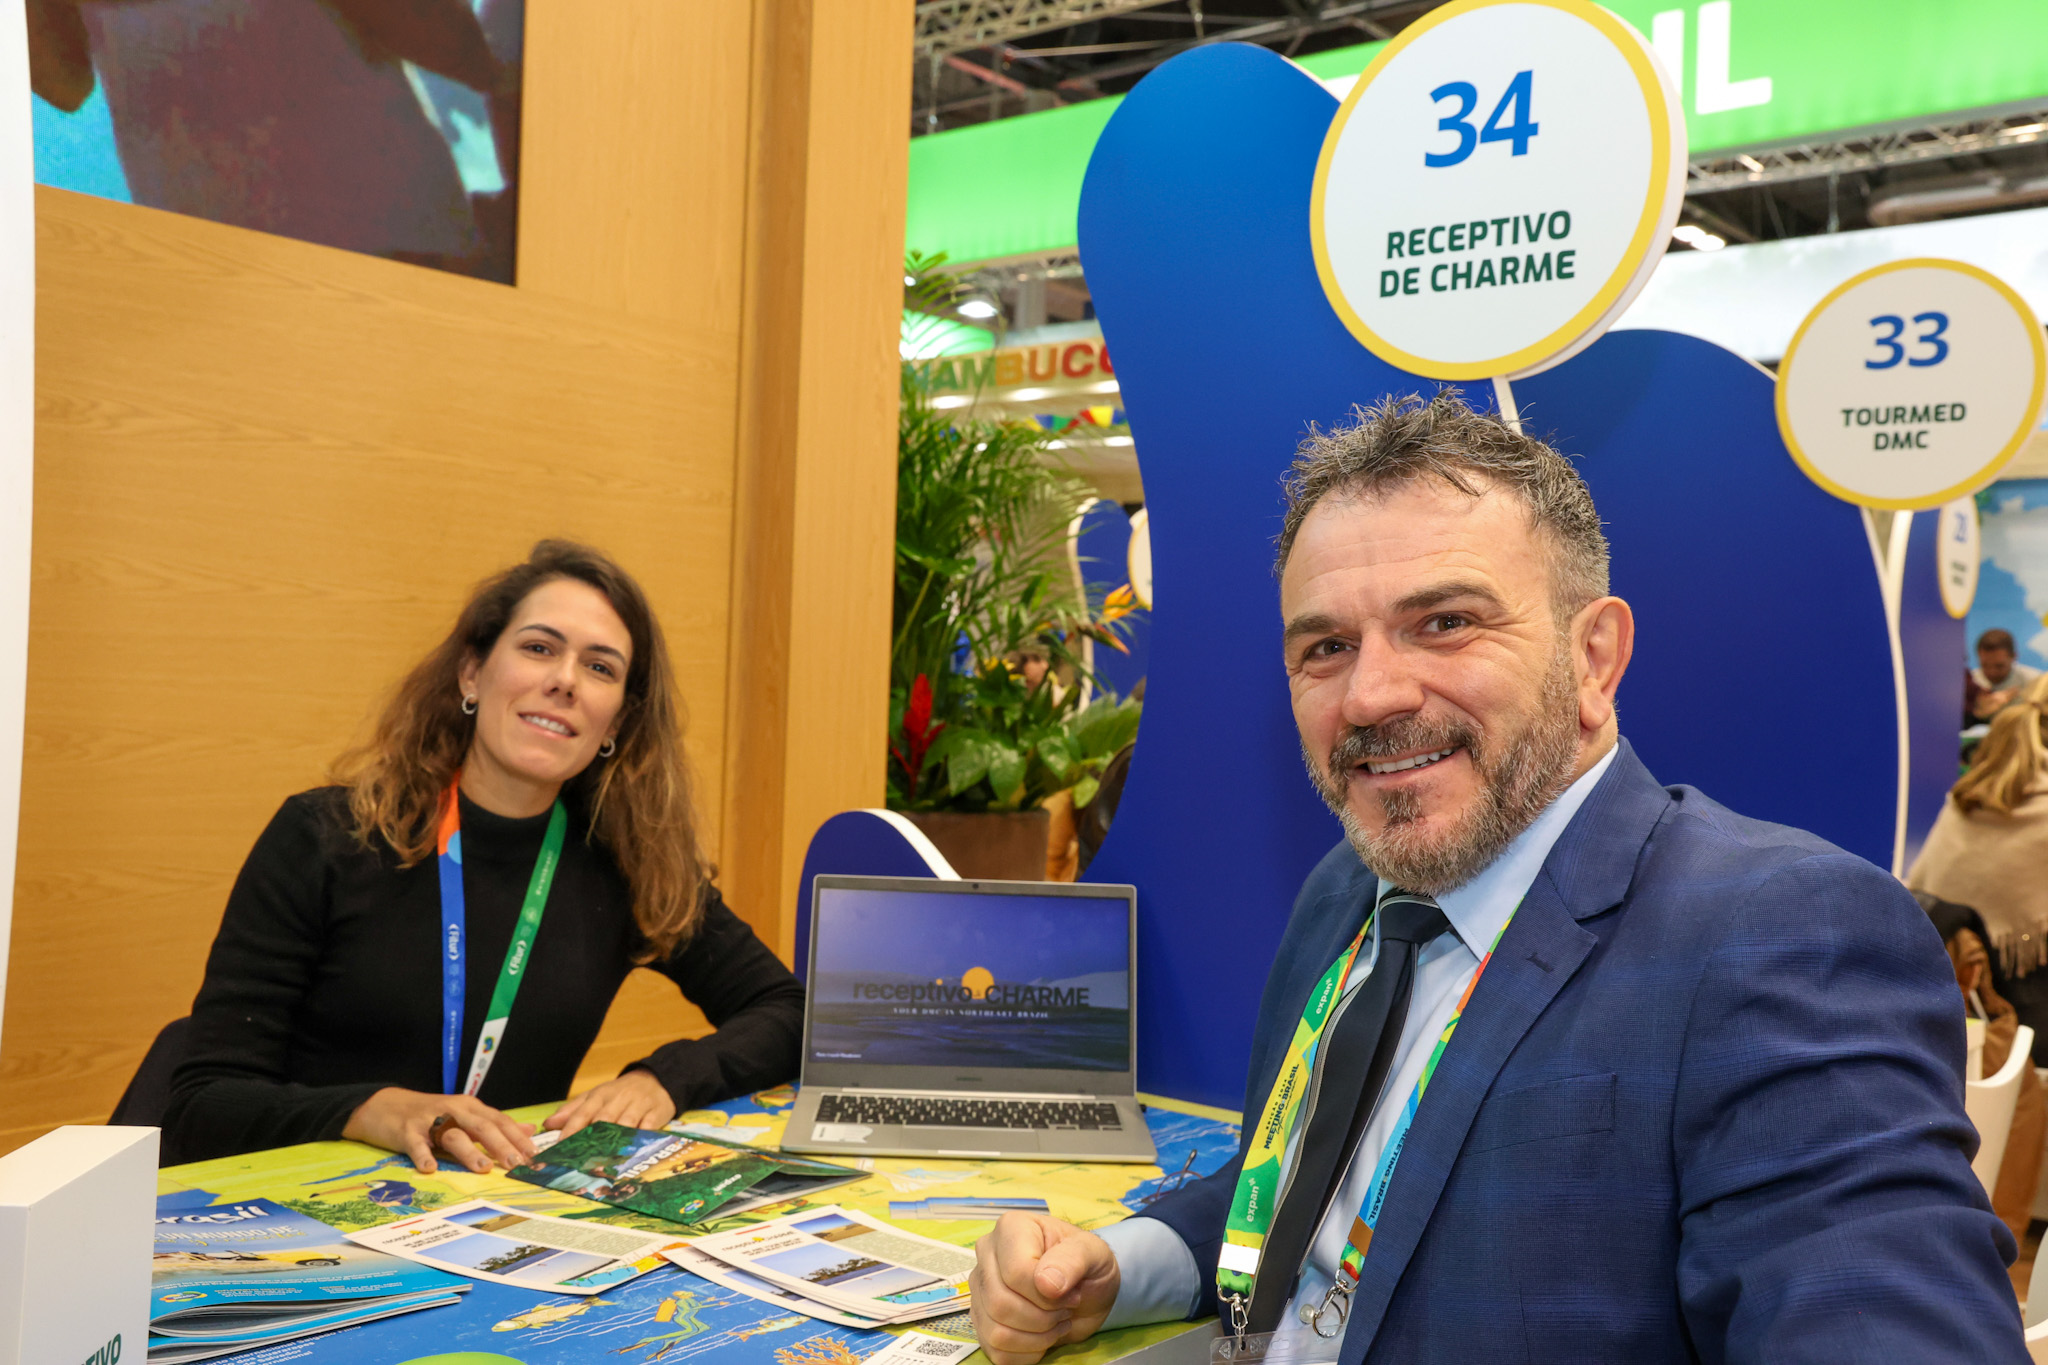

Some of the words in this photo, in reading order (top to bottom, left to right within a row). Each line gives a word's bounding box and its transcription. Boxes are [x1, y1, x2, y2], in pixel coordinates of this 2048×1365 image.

[1424, 69, 1540, 168] 34
[1386, 210, 1571, 259] RECEPTIVO
[1379, 267, 1421, 298] DE
[1431, 250, 1576, 293] CHARME
[1864, 311, 1950, 370] 33
[1841, 403, 1966, 427] TOURMED
[1873, 430, 1930, 451] DMC
[852, 978, 973, 1006] receptivo
[985, 985, 1090, 1009] CHARME
[1315, 982, 1333, 1015] expan
[1263, 1104, 1286, 1150] MEETING
[1281, 1063, 1300, 1100] BRASIL
[616, 1142, 684, 1180] BRASIL
[156, 1206, 269, 1224] rasil
[1246, 1184, 1260, 1223] expan
[1367, 1180, 1386, 1221] BRASIL
[191, 1229, 268, 1240] MUNDO
[266, 1225, 299, 1235] DE
